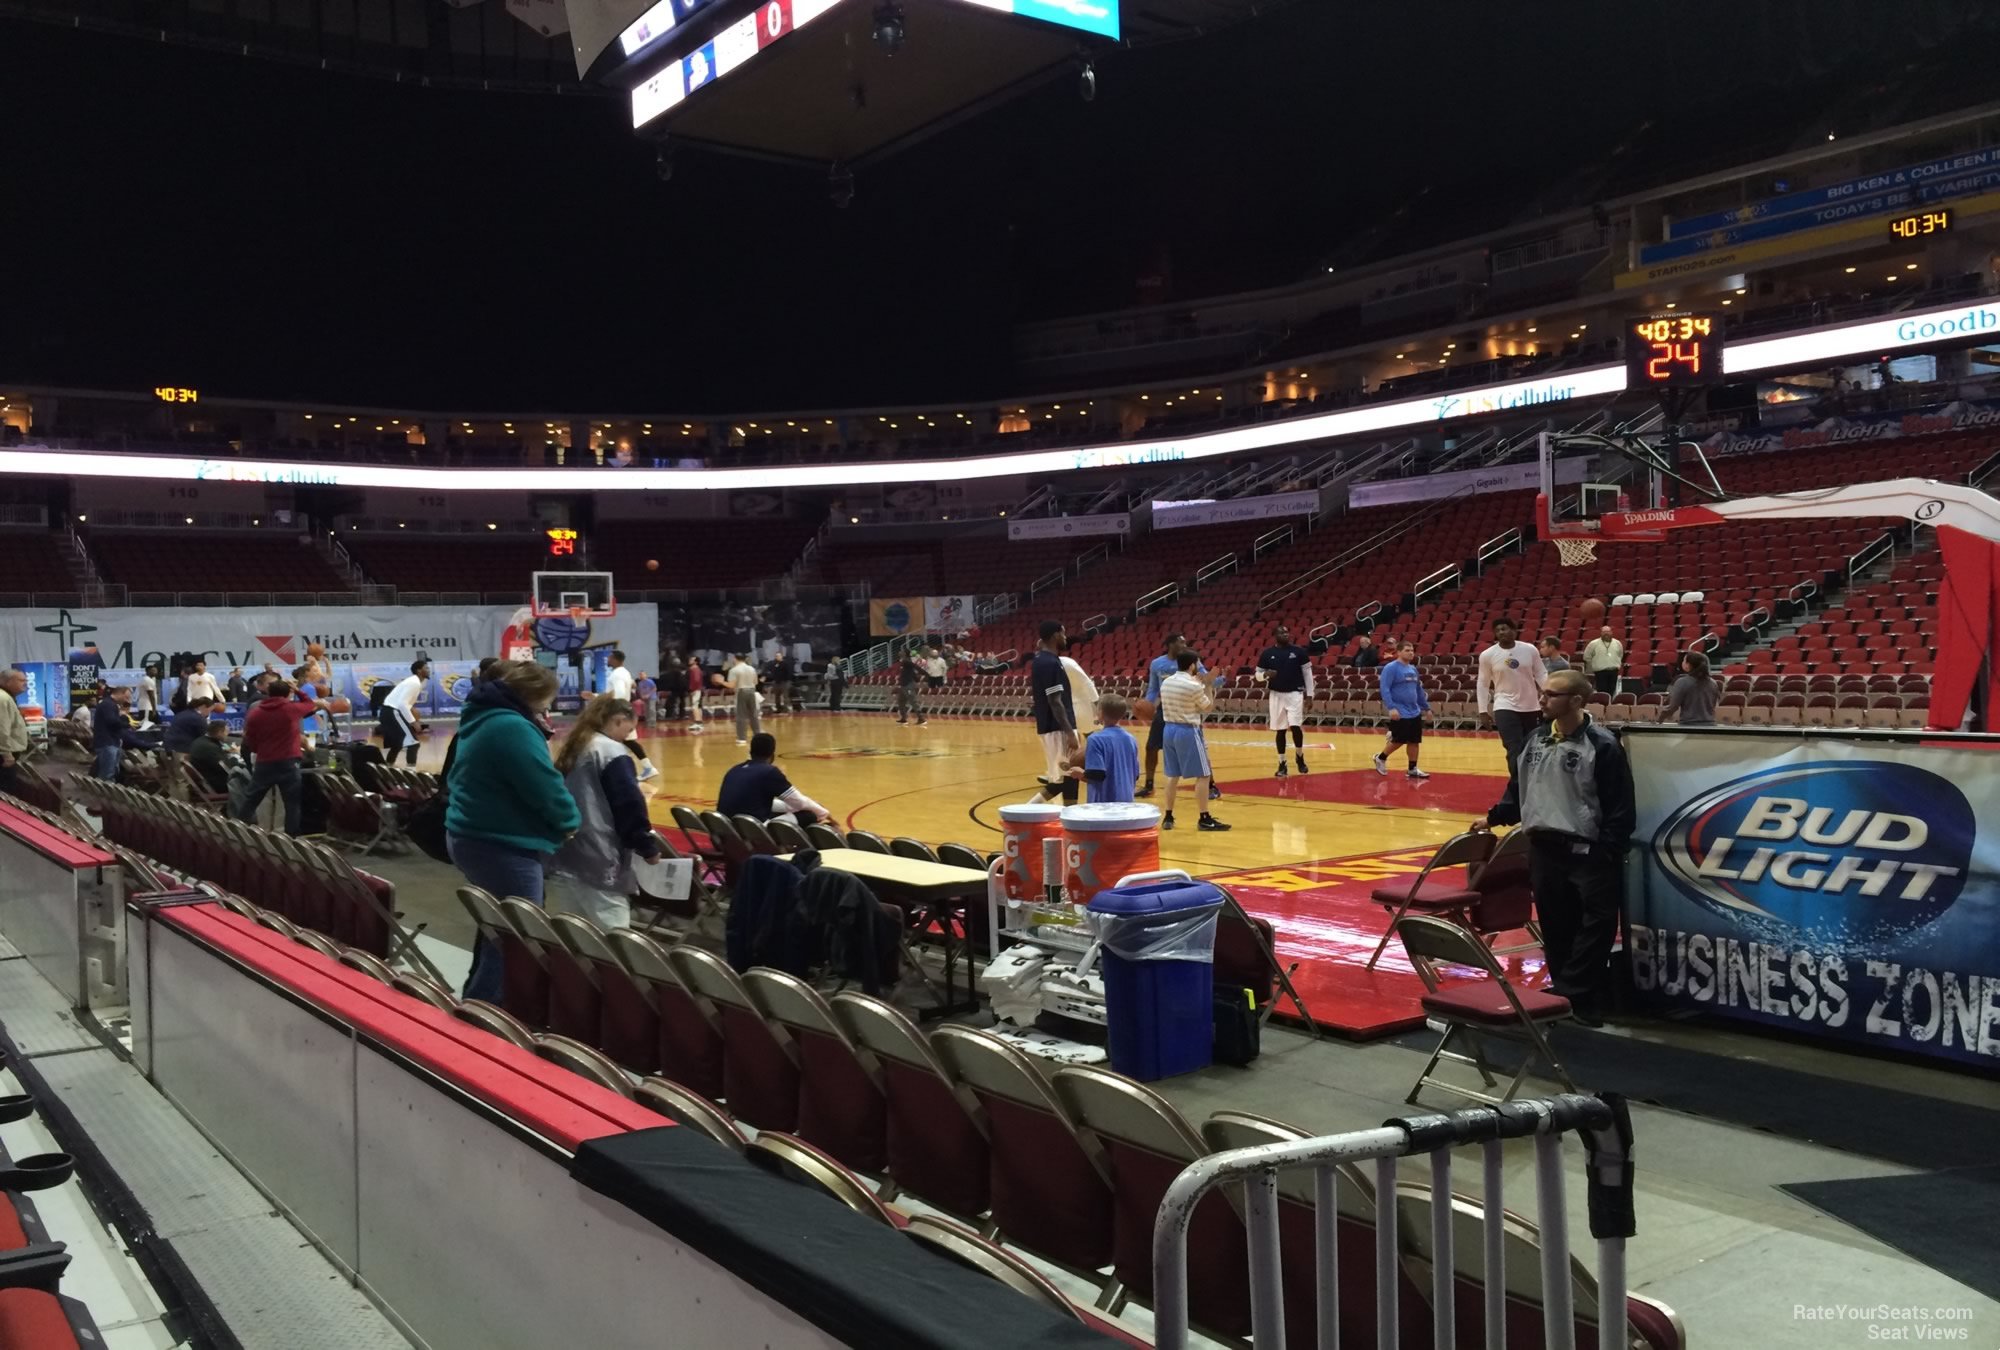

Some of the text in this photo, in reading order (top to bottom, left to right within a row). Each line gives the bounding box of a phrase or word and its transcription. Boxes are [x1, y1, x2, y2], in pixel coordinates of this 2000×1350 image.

[767, 2, 782, 37] 0
[1827, 183, 1854, 199] BIG
[1858, 175, 1890, 191] KEN
[1895, 172, 1905, 183] &
[1911, 154, 1987, 179] COLLEEN
[1815, 199, 1883, 222] TODAY'S
[1892, 212, 1947, 237] 40:34
[1638, 319, 1711, 341] 40:34
[1650, 342, 1700, 378] 24
[156, 388, 197, 402] 40:34
[1832, 423, 1888, 441] LIGHT
[1721, 438, 1771, 453] LIGHT
[168, 487, 199, 498] 110
[1624, 510, 1675, 525] SPALDING
[553, 539, 573, 555] 24
[301, 631, 457, 650] MidAmerican
[72, 664, 96, 672] DON'T
[1735, 796, 1929, 852] BUD
[1003, 835, 1019, 858] G
[1066, 843, 1081, 868] G
[1698, 837, 1961, 901] LIGHT
[1629, 923, 2000, 1058] BUSINESS ZONE
